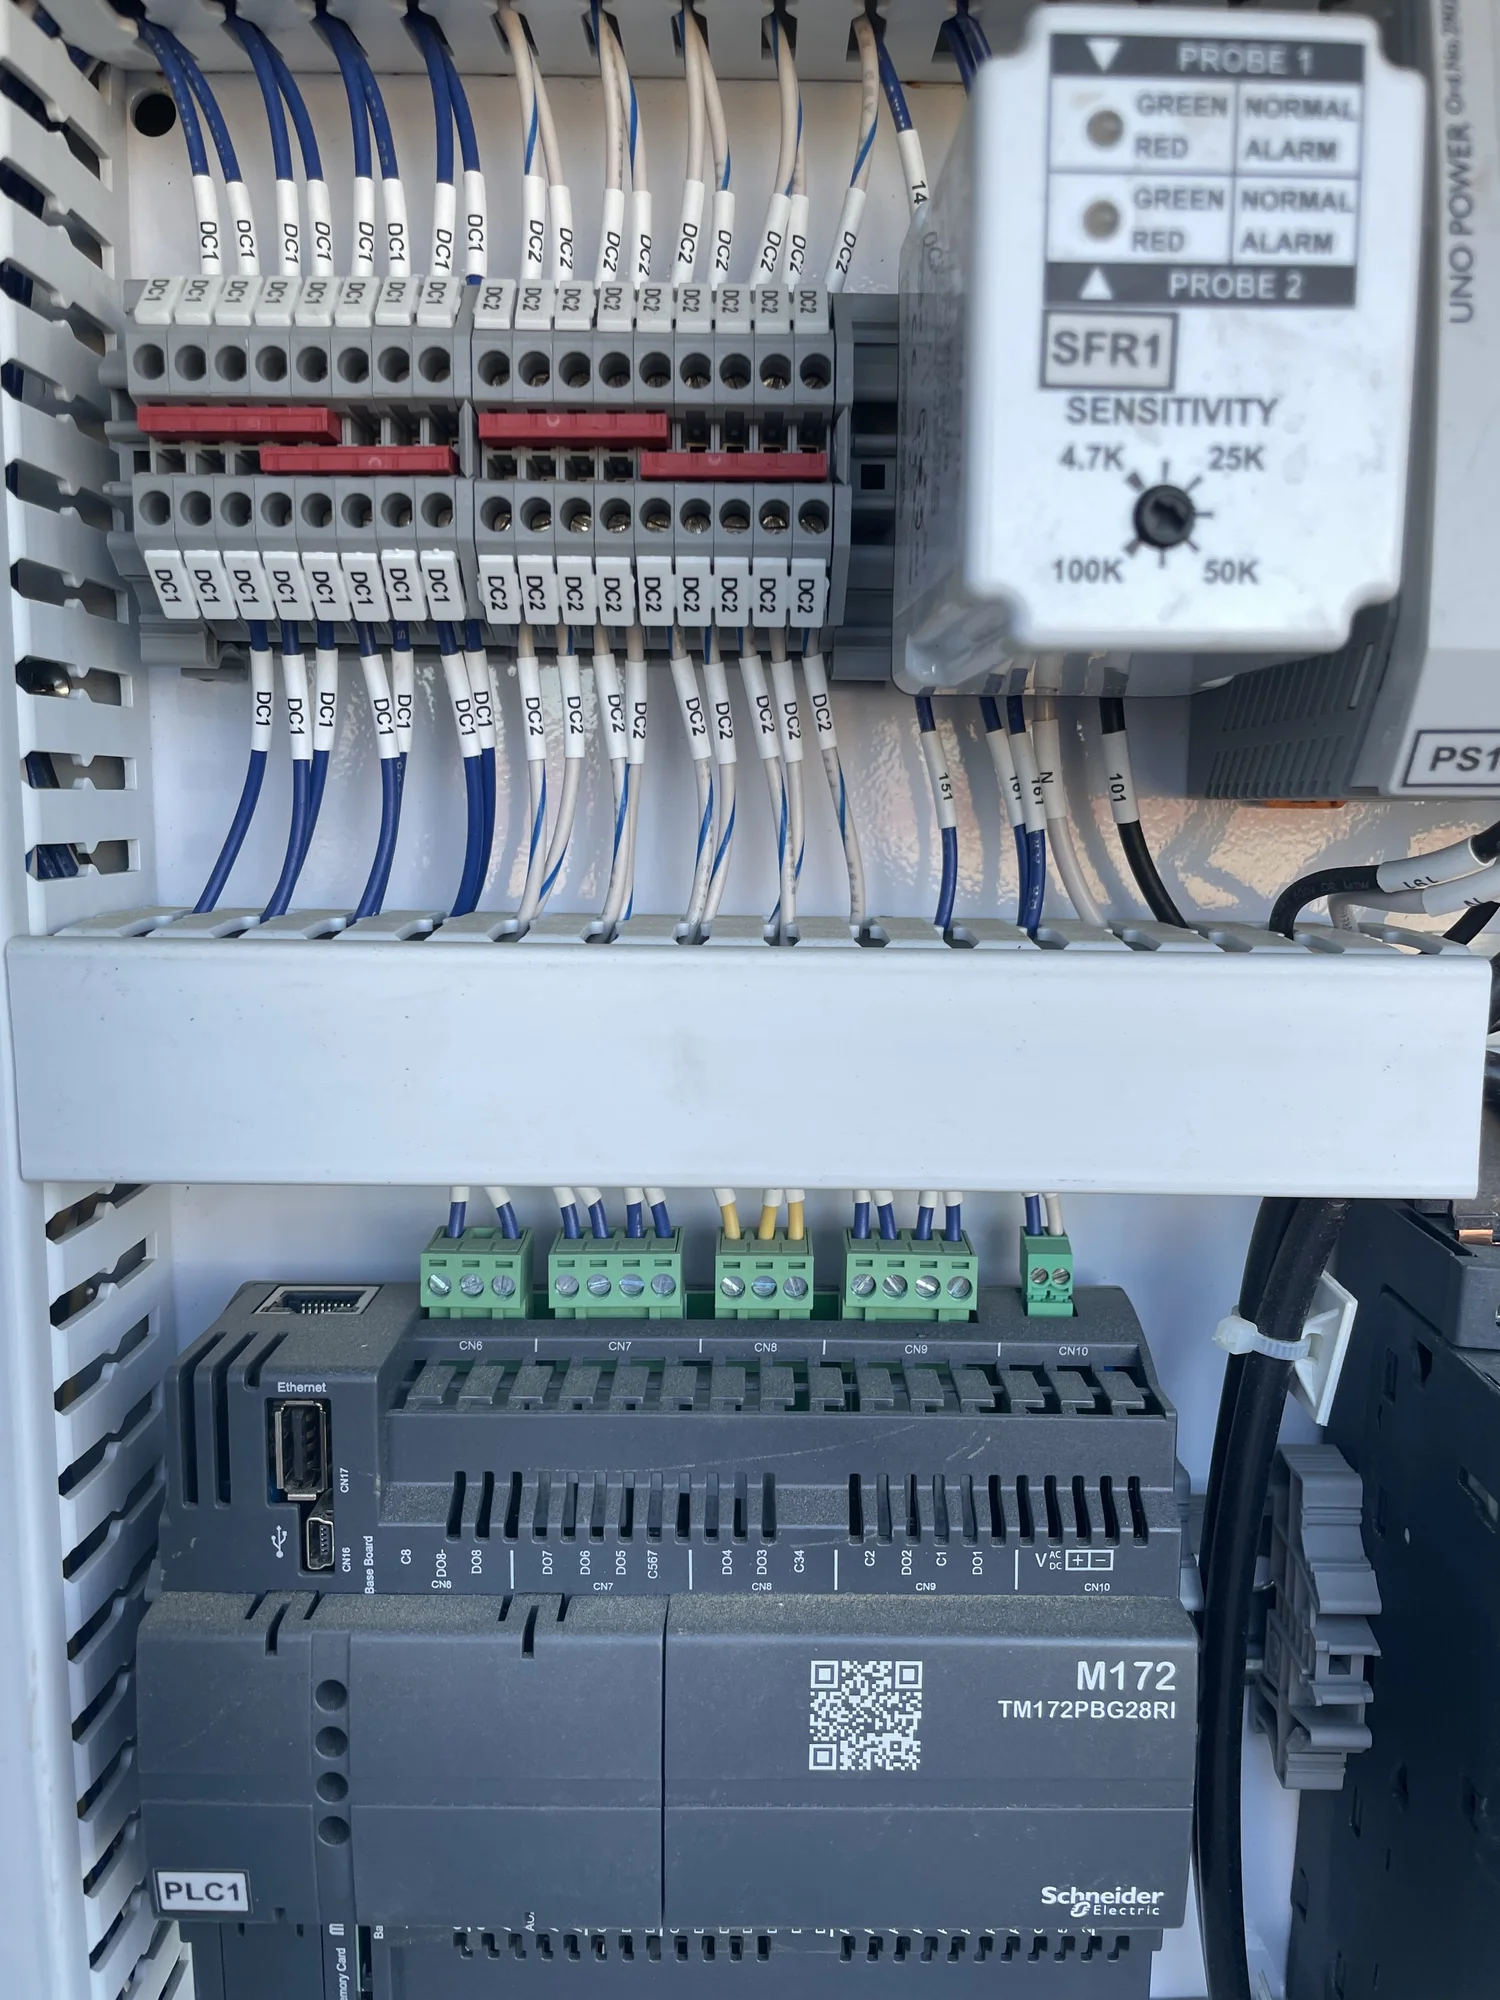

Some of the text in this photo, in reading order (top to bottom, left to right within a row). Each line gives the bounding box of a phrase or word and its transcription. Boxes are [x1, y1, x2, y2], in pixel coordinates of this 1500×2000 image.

[1178, 46, 1313, 75] PROBE 1
[1136, 95, 1228, 117] GREEN
[1245, 97, 1357, 121] NORMAL
[1135, 136, 1189, 159] RED
[1245, 140, 1337, 162] ALARM
[1447, 121, 1473, 236] POWER
[1133, 188, 1225, 210] GREEN
[1242, 190, 1355, 213] NORMAL
[200, 221, 219, 261] DC1
[237, 219, 256, 259] DC1
[284, 223, 299, 264] DC1
[315, 222, 332, 262] DC1
[359, 222, 374, 263] DC1
[388, 222, 405, 262] DC1
[468, 214, 484, 253] DC1
[528, 220, 544, 264] DC2
[678, 223, 698, 265] DC2
[1131, 231, 1185, 252] RED
[1241, 232, 1333, 254] ALARM
[435, 229, 453, 270] DC1
[560, 228, 573, 270] DC2
[603, 232, 621, 273] DC2
[638, 234, 652, 276] DC2
[716, 230, 732, 273] DC2
[760, 231, 782, 273] DC2
[790, 234, 807, 275] DC2
[836, 231, 857, 275] DC2
[145, 280, 170, 301] DC1
[185, 280, 209, 302] DC1
[225, 281, 248, 302] DC1
[265, 282, 288, 303] DC1
[304, 282, 327, 304] DC1
[344, 282, 366, 305] DC1
[386, 282, 406, 304] DC1
[425, 282, 447, 305] DC1
[485, 286, 503, 311] DC2
[522, 287, 542, 312] DC2
[603, 287, 623, 311] DC2
[1169, 272, 1302, 299] PROBE 2
[1449, 246, 1474, 324] UNO
[563, 288, 581, 312] DC2
[643, 288, 661, 312] DC2
[682, 289, 701, 313] DC2
[722, 289, 740, 314] DC2
[761, 290, 778, 314] DC2
[800, 290, 817, 314] DC2
[1051, 330, 1160, 368] SFR1
[1066, 396, 1278, 426] SENSITIVITY
[1059, 445, 1124, 471] 4.7K
[1208, 445, 1265, 471] 25K
[389, 568, 413, 604] DC1
[1053, 559, 1124, 584] 100K
[1203, 560, 1259, 584] 50K
[154, 569, 182, 604] DC1
[194, 569, 221, 604] DC1
[233, 570, 260, 605] DC1
[272, 570, 298, 605] DC1
[311, 571, 337, 605] DC1
[350, 571, 375, 607] DC1
[428, 568, 451, 605] DC1
[488, 576, 508, 610] DC2
[526, 575, 546, 611] DC2
[565, 576, 584, 612] DC2
[603, 577, 622, 613] DC2
[643, 576, 662, 613] DC2
[682, 577, 701, 613] DC2
[721, 577, 739, 613] DC2
[759, 577, 777, 614] DC2
[797, 577, 816, 614] DC2
[255, 691, 272, 727] DC1
[287, 698, 305, 735] DC1
[319, 692, 336, 728] DC1
[373, 698, 394, 735] DC1
[396, 694, 412, 728] DC1
[455, 698, 477, 735] DC1
[473, 690, 493, 726] DC1
[524, 697, 545, 737] DC2
[566, 696, 584, 735] DC2
[607, 694, 626, 734] DC2
[632, 702, 648, 740] DC2
[684, 697, 706, 737] DC2
[714, 701, 734, 740] DC2
[755, 695, 775, 735] DC2
[783, 701, 802, 741] DC2
[811, 694, 833, 733] DC2
[1428, 746, 1500, 772] PS1
[938, 772, 954, 802] 151
[1031, 777, 1045, 805] 161
[1039, 771, 1054, 784] N
[1109, 773, 1127, 803] 101
[459, 1340, 483, 1351] CN6
[608, 1341, 633, 1352] CN7
[754, 1342, 778, 1353] CN8
[904, 1344, 928, 1355] CN9
[1058, 1346, 1089, 1357] CN10
[277, 1382, 327, 1393] Ethernet
[339, 1467, 349, 1493] CN17
[341, 1546, 351, 1573] CN16
[363, 1535, 375, 1594] Base Board
[400, 1549, 412, 1565] C8
[647, 1550, 658, 1579] C567
[793, 1550, 805, 1573] C34
[864, 1550, 875, 1567] C2
[936, 1551, 947, 1567] C1
[1035, 1553, 1047, 1568] V
[1049, 1551, 1061, 1559] AC
[1049, 1562, 1062, 1570] DC
[593, 1582, 614, 1591] CN7
[751, 1583, 772, 1591] CN8
[915, 1583, 936, 1592] CN9
[1084, 1583, 1110, 1592] CN10
[1077, 1661, 1176, 1691] M172
[998, 1700, 1176, 1719] TM172PBG28RI
[164, 1881, 240, 1902] PLC1
[1041, 1886, 1165, 1905] Schneider
[1093, 1905, 1160, 1916] Electric
[336, 1947, 347, 1972] Card
